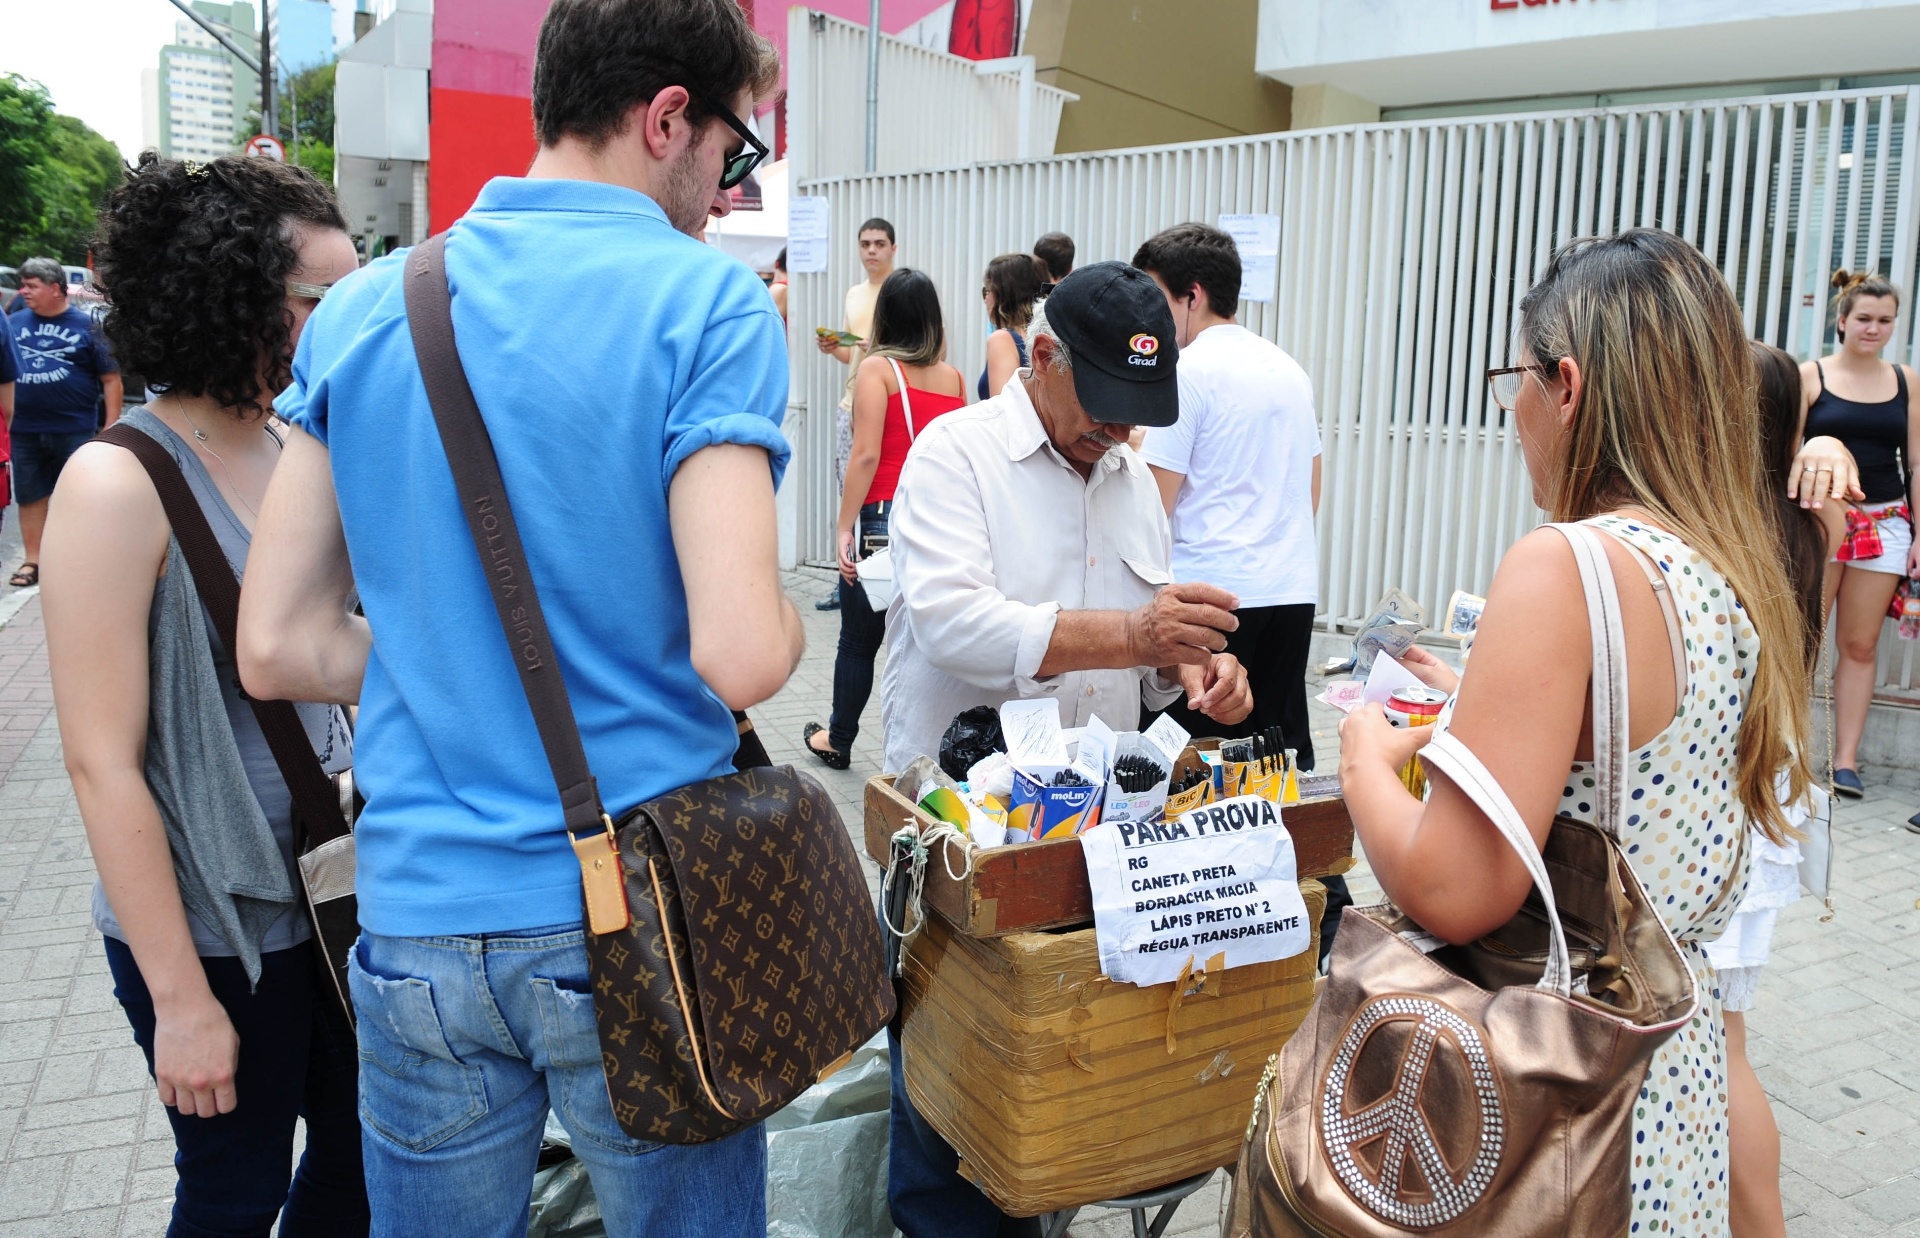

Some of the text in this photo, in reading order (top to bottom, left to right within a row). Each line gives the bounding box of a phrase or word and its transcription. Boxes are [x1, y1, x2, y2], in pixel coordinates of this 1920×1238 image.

[34, 323, 81, 345] JOLLA
[1128, 355, 1157, 366] Graal
[16, 366, 71, 384] IFORNIA
[474, 495, 543, 671] LOUIS VUITTON
[1110, 800, 1150, 810] LEO LEO
[1176, 791, 1197, 806] BIC
[1117, 822, 1190, 847] PARA
[1191, 800, 1278, 836] PROVA
[1128, 856, 1149, 870] RG
[1131, 865, 1237, 893] CANETA PRETA
[1135, 881, 1259, 913] BORRACHA MACIA
[1150, 912, 1193, 932] LÁPIS
[1196, 905, 1243, 925] PRETO
[1263, 901, 1271, 913] 2
[1138, 915, 1300, 954] RÉGUA TRANSPARENTE
